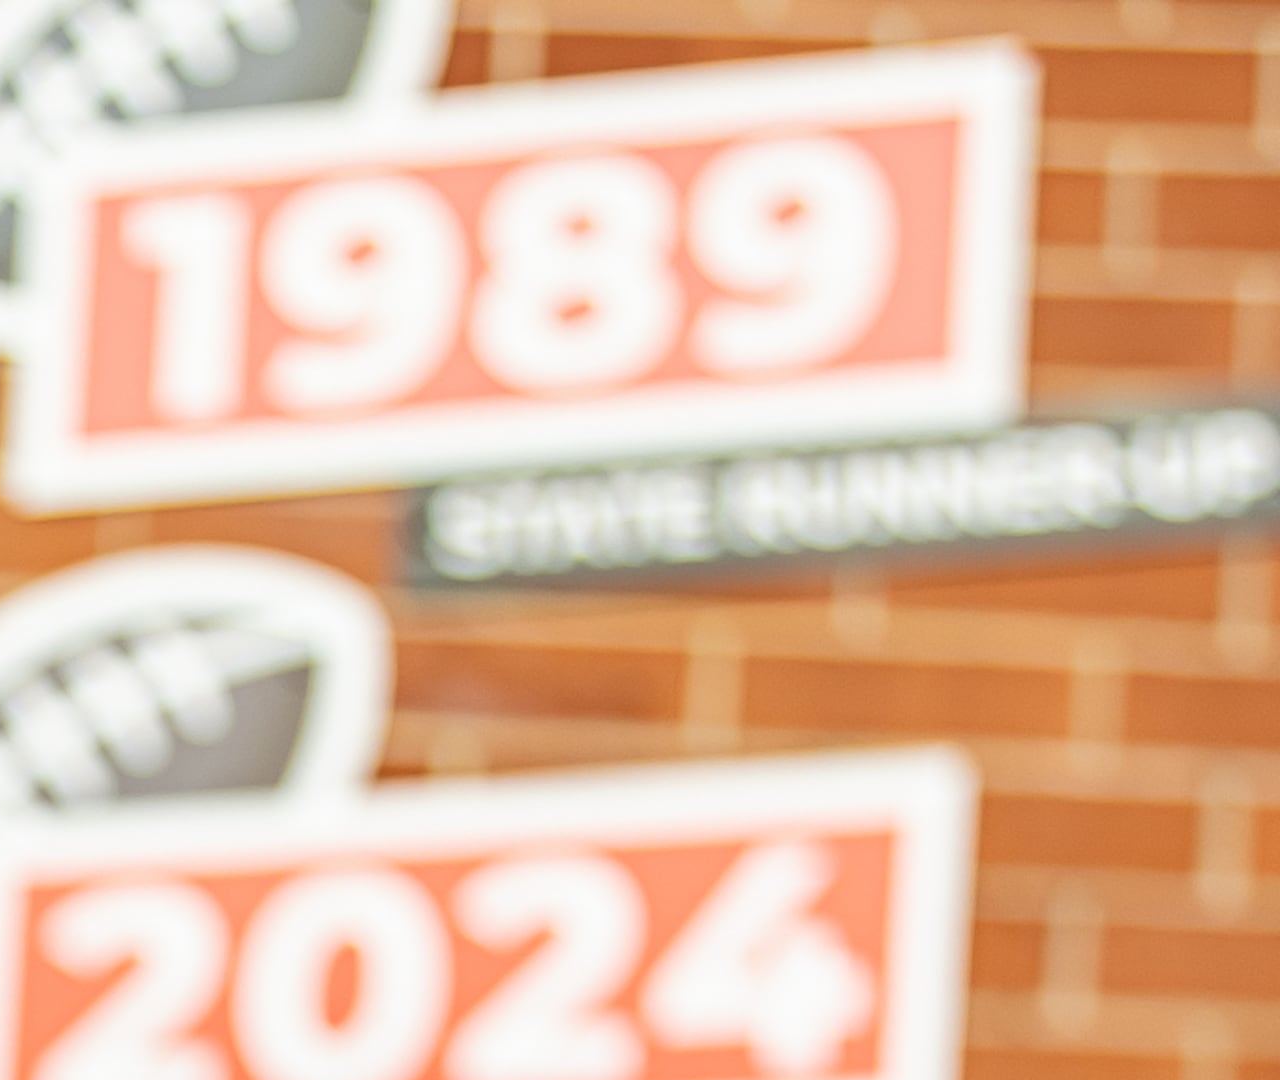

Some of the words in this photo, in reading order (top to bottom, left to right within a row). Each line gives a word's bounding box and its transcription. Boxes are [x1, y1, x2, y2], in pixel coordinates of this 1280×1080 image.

[116, 130, 905, 428] 1989
[427, 464, 714, 580] STATE
[718, 423, 1126, 556] RUNNER
[1130, 409, 1279, 523] UP
